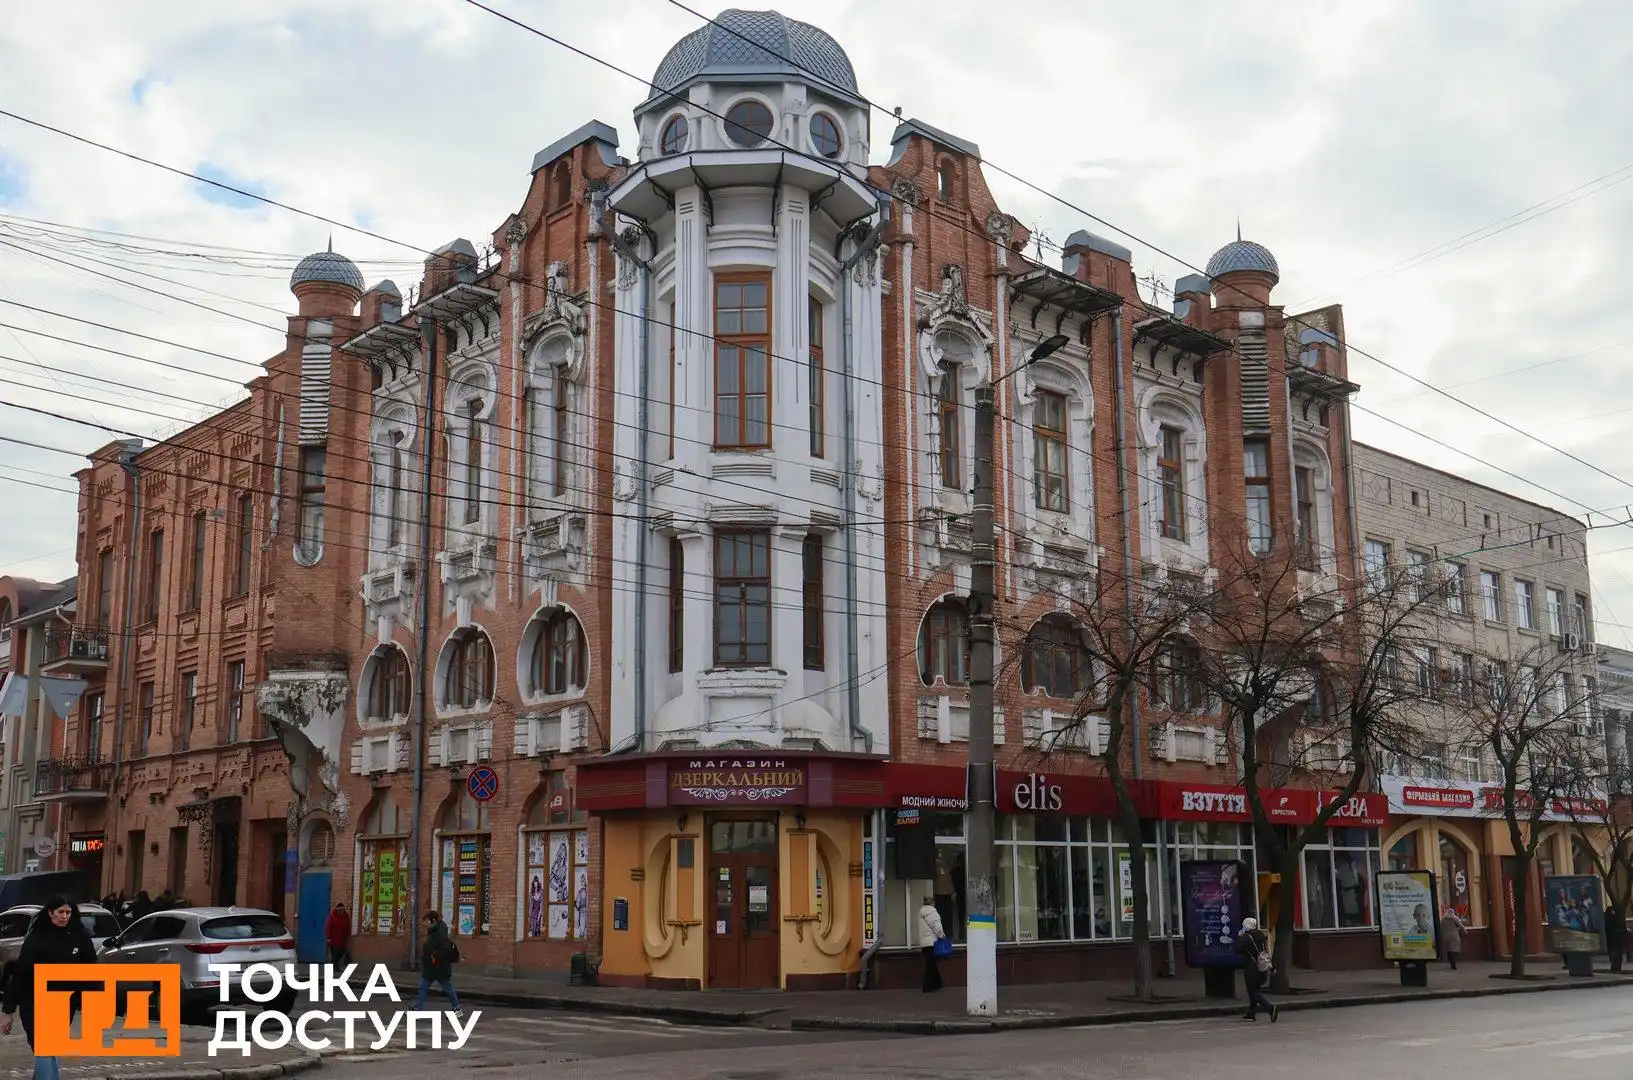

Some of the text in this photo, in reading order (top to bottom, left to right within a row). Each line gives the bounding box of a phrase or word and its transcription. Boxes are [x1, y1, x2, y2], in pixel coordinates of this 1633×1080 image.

[689, 760, 786, 768] МАГАЗИН
[671, 768, 804, 788] ДЗЕРКАЛЬНИЙ
[1014, 772, 1062, 810] elis
[902, 795, 936, 809] МОДНИЙ
[1181, 791, 1246, 813] ВЗУТТЯ
[896, 817, 920, 825] ВАЛЮТ
[865, 896, 873, 939] ВАЛЮТ
